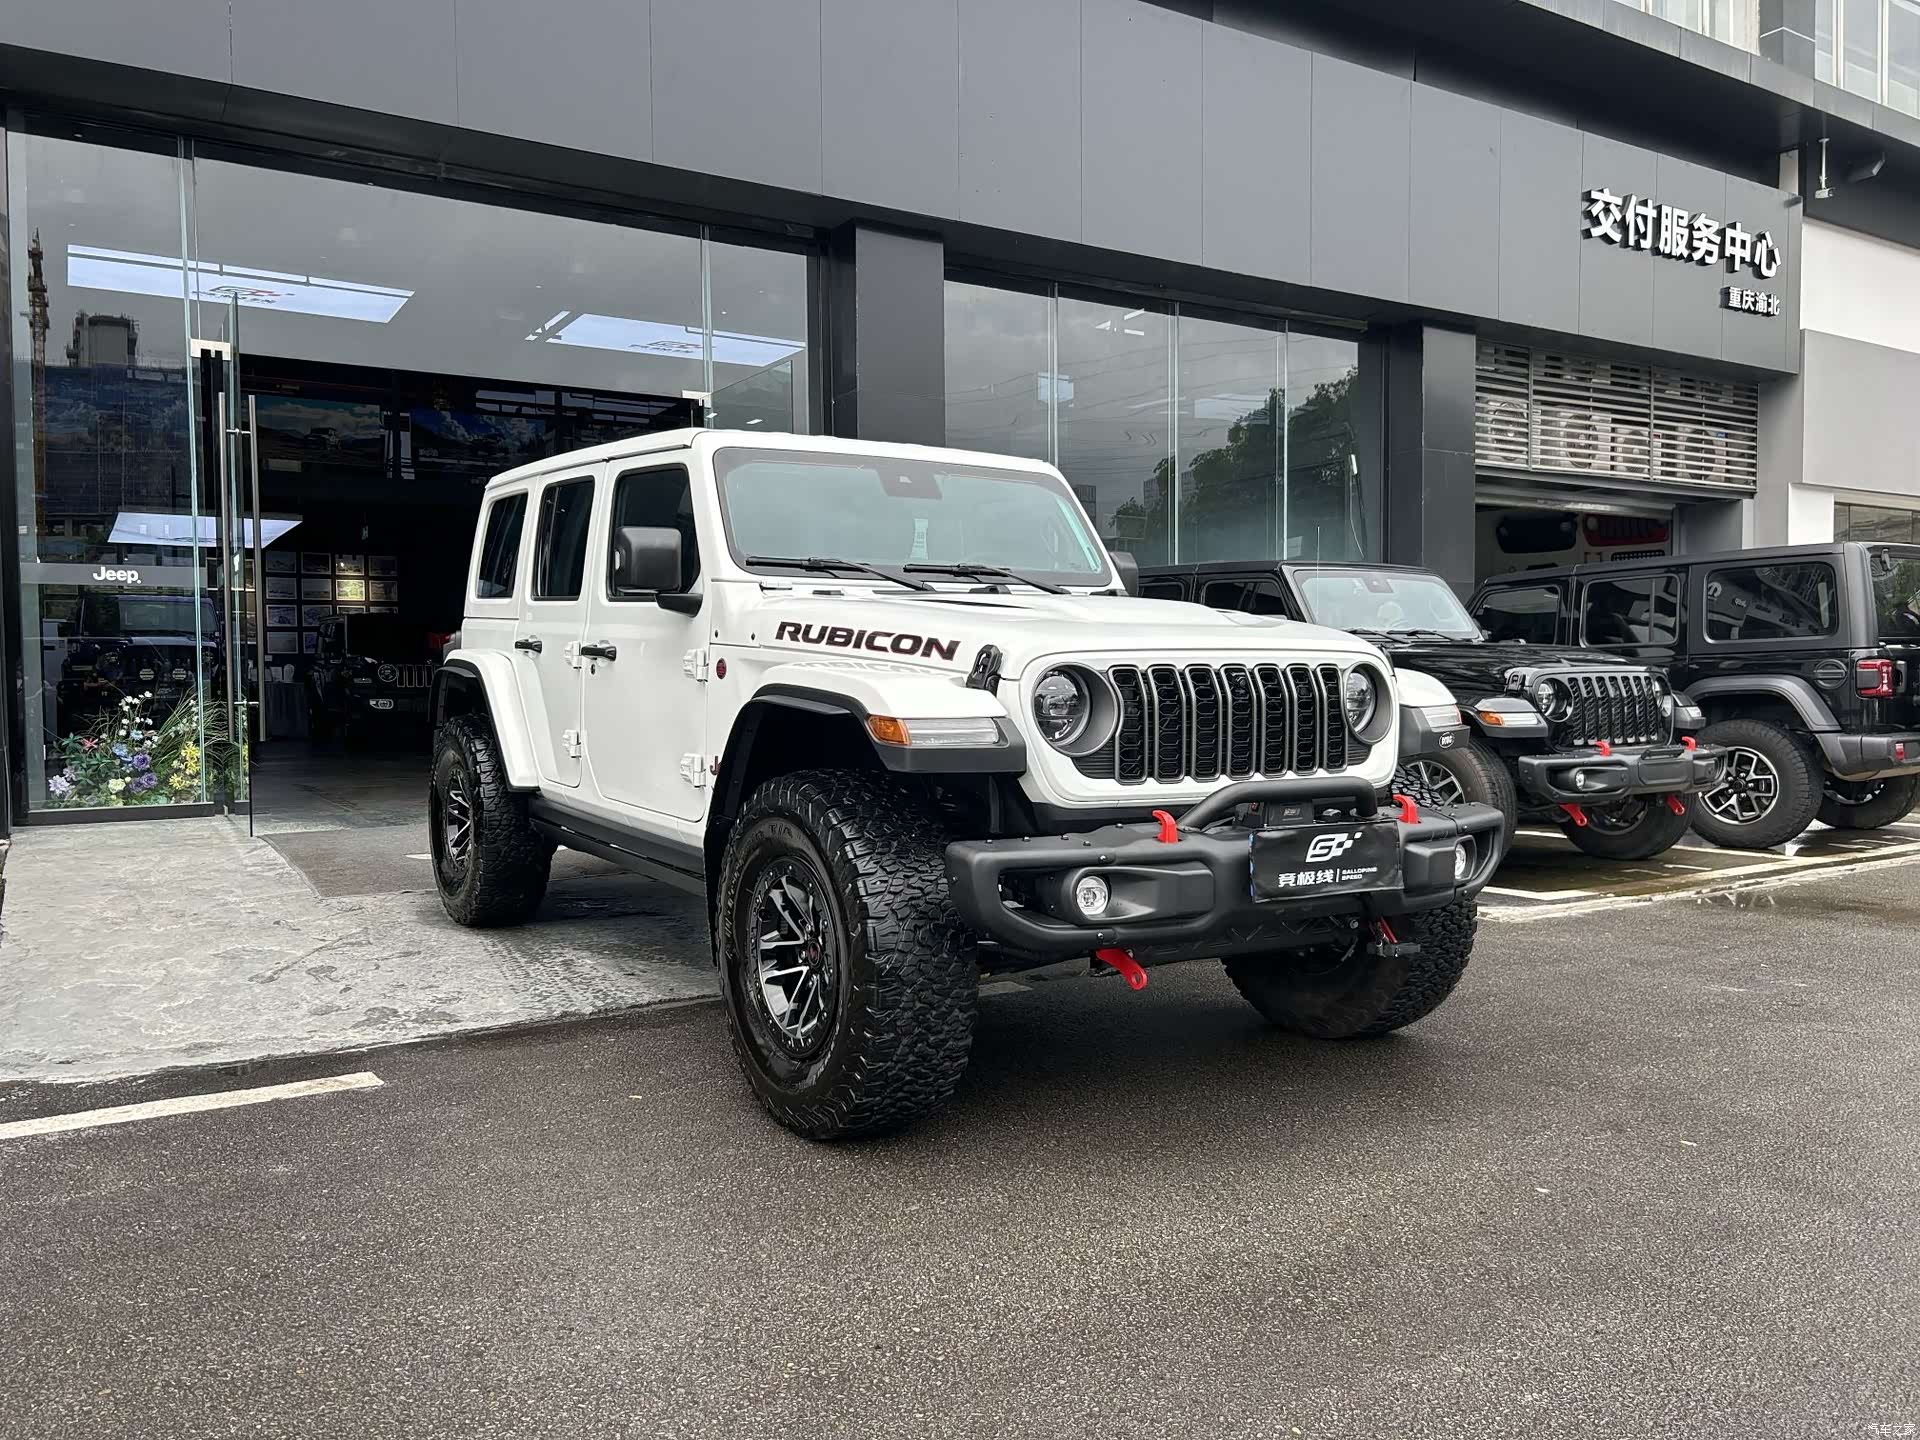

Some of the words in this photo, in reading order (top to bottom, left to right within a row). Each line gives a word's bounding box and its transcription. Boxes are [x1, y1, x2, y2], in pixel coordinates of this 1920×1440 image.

[1587, 188, 1782, 278] 交付服务中心
[1727, 286, 1780, 315] 重庆渝北
[775, 621, 961, 662] RUBICON
